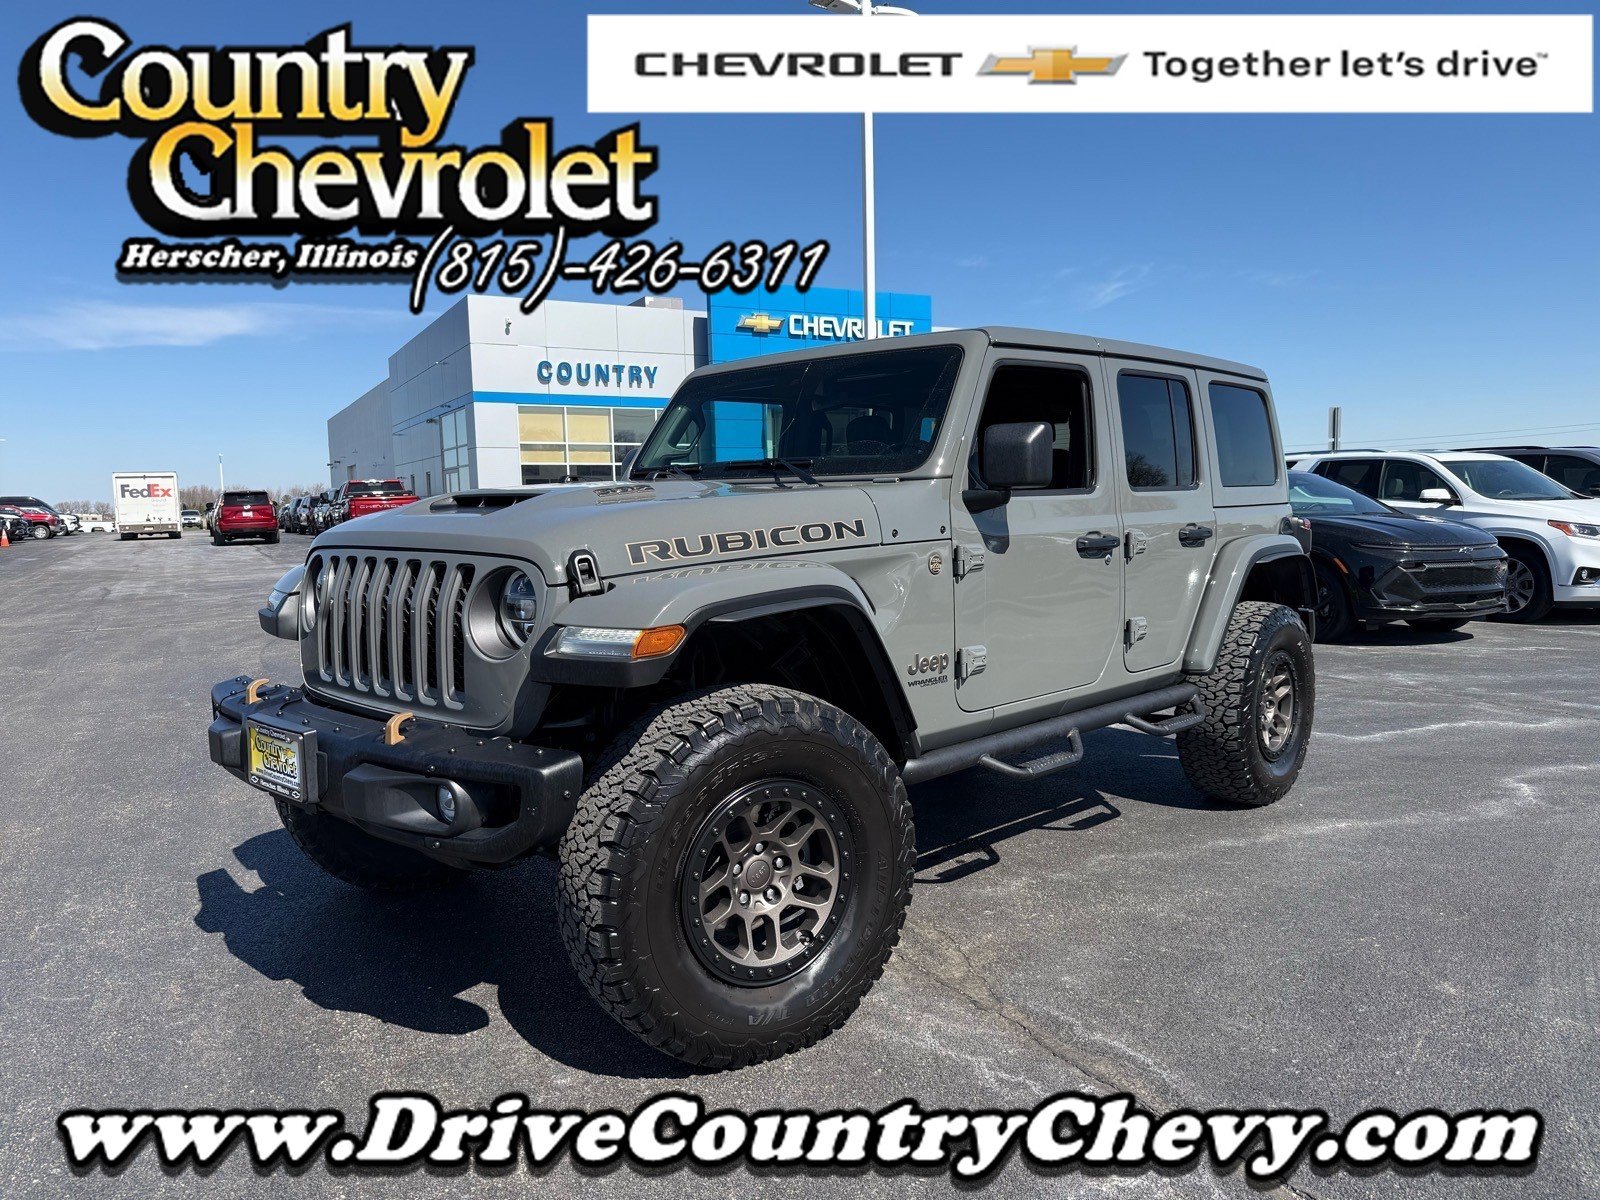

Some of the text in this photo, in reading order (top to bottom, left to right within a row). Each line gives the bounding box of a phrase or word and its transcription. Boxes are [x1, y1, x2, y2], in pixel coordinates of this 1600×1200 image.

[789, 314, 914, 339] CHEVRLET
[537, 360, 659, 387] COUNTRY
[120, 484, 173, 499] FedEx
[625, 518, 867, 566] RUBICON
[907, 652, 950, 676] Jeep
[907, 674, 948, 687] WRANGLER
[255, 734, 284, 760] Country
